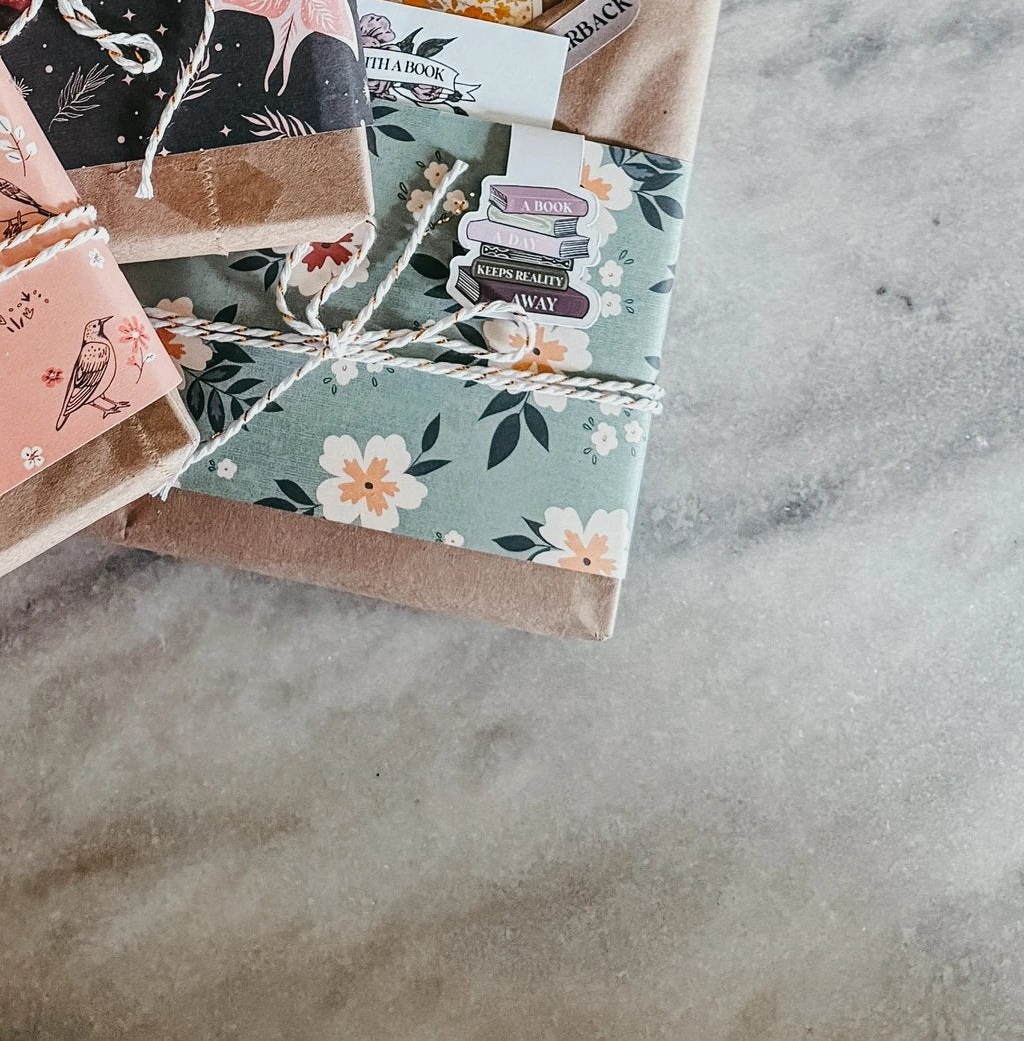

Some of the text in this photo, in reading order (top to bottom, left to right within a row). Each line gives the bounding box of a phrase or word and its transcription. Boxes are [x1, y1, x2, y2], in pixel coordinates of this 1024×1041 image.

[364, 56, 447, 82] ITH A BOOK
[521, 200, 574, 214] A BOOK
[492, 232, 538, 251] A DAY
[477, 264, 564, 287] KEEPS REALITY
[511, 293, 558, 312] AWAY
